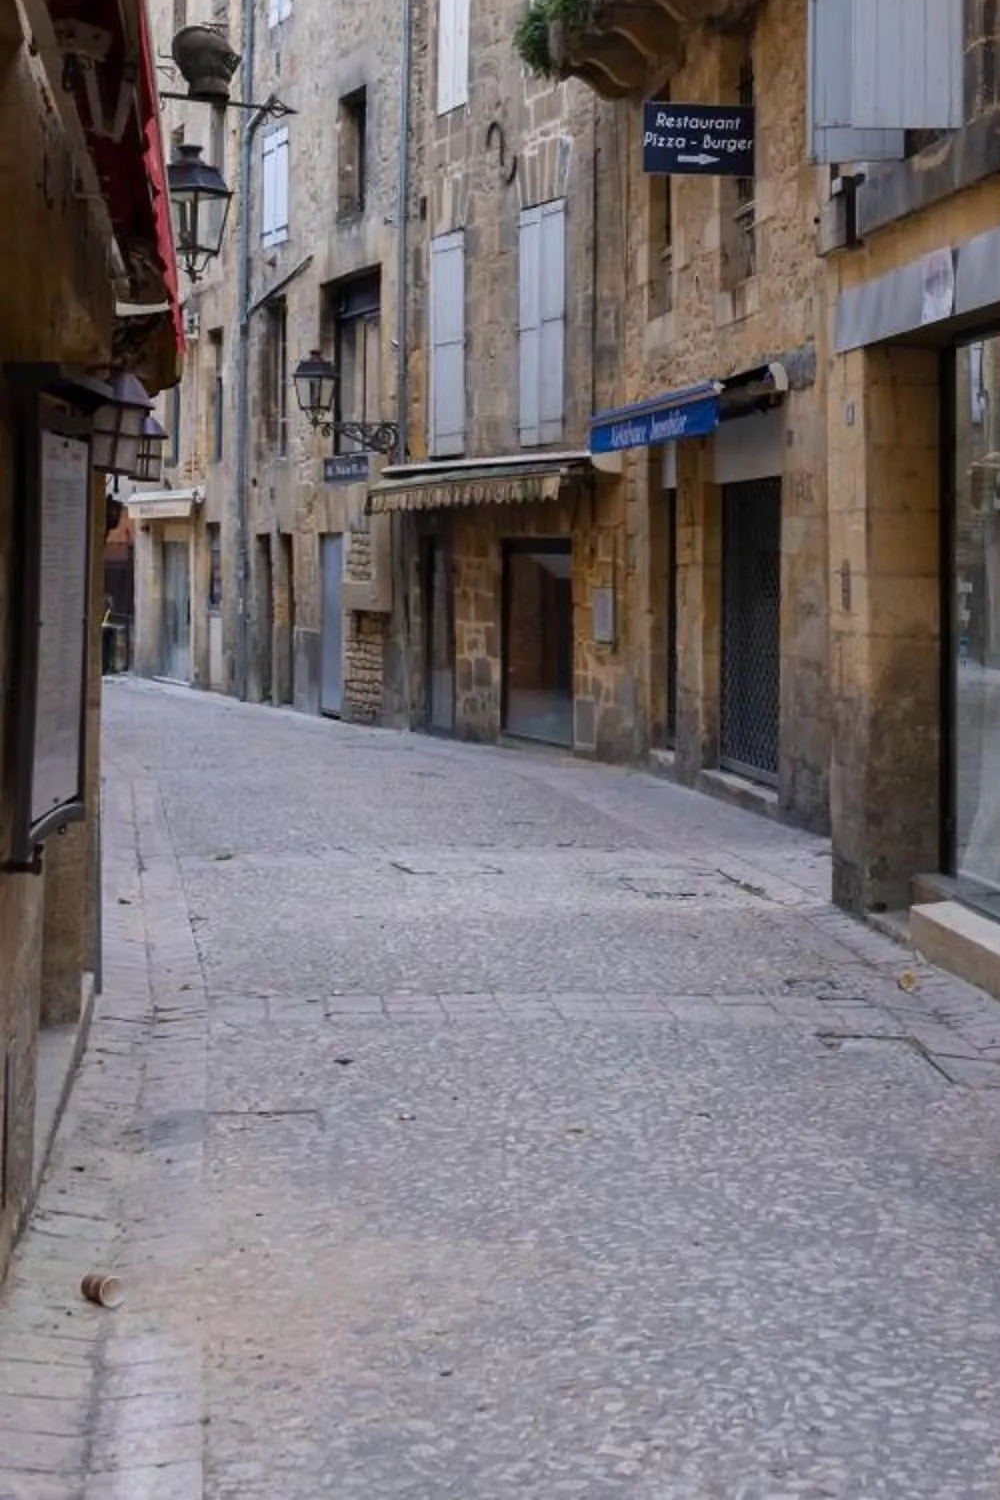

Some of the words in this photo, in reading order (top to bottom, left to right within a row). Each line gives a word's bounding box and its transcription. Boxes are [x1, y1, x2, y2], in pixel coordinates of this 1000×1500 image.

[656, 111, 740, 130] Restaurant
[643, 131, 686, 149] Pizza
[703, 133, 752, 153] Burger
